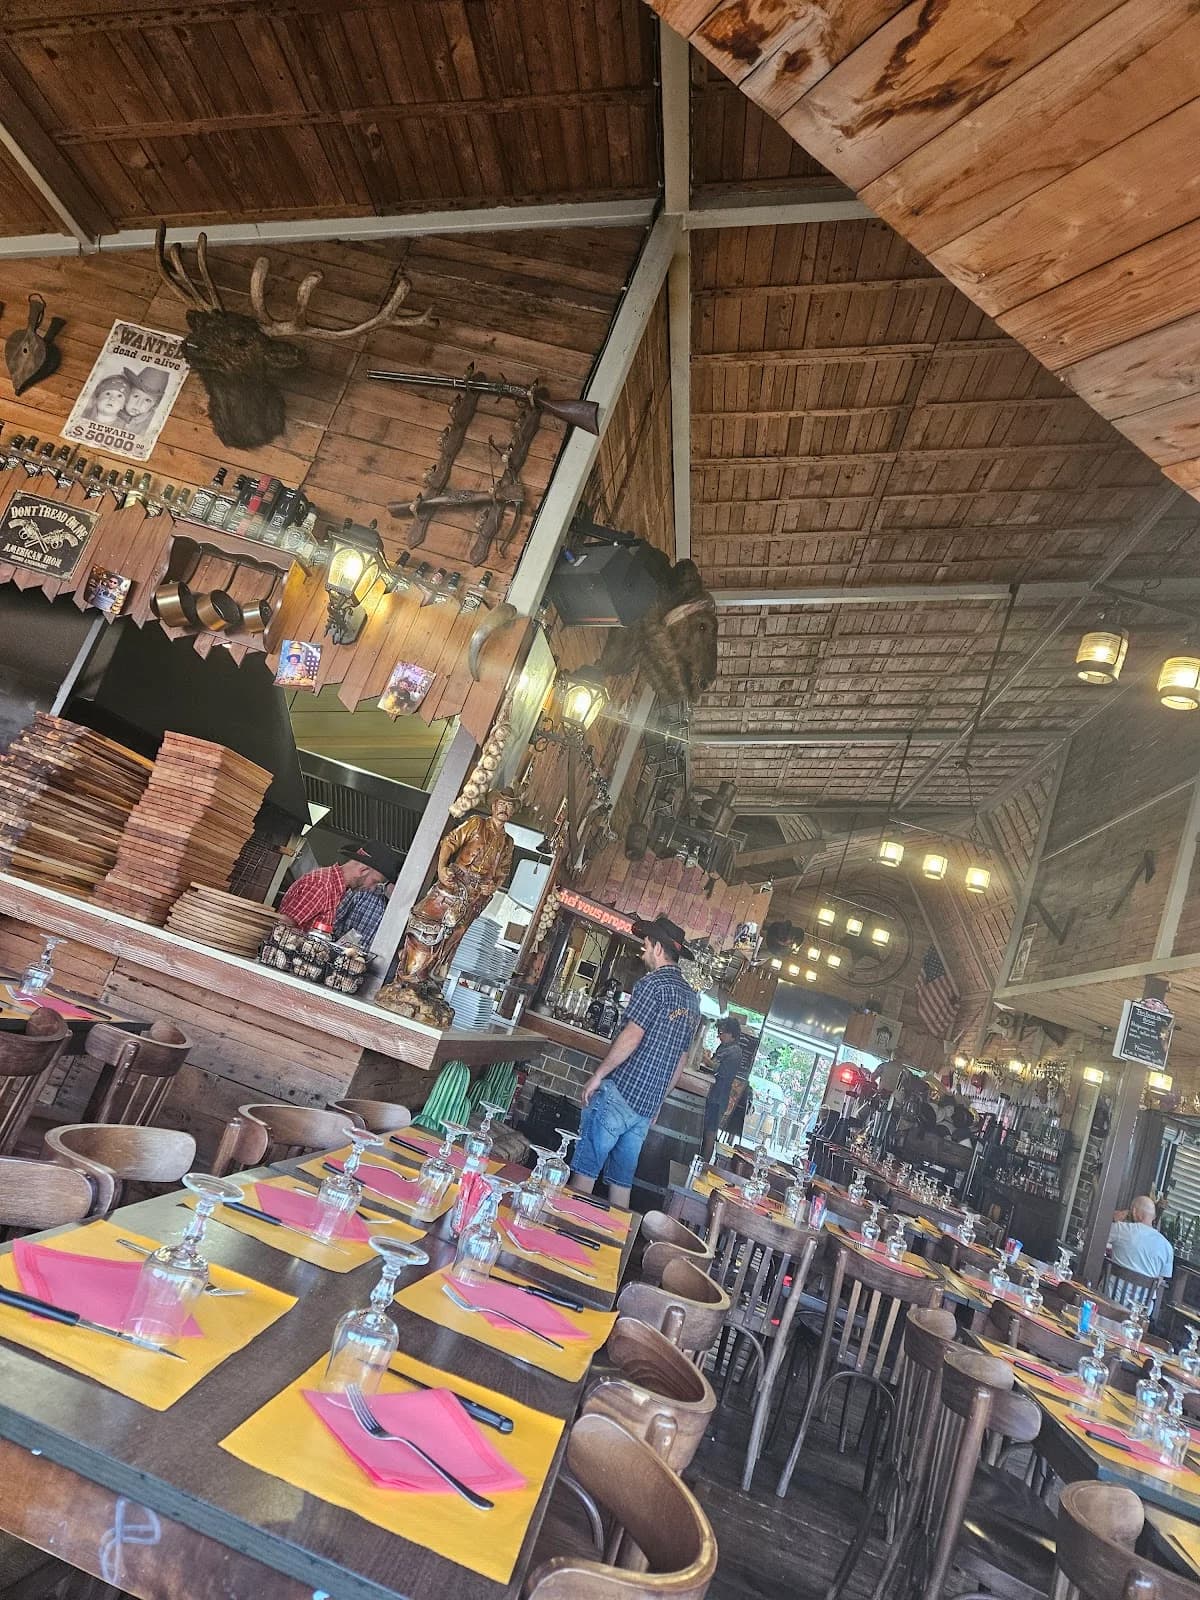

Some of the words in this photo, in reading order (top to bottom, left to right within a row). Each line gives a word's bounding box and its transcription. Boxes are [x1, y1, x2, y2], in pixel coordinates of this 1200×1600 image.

[113, 345, 138, 359] dead
[140, 354, 153, 363] or
[154, 357, 181, 371] alive
[88, 422, 136, 441] REWARD
[39, 504, 68, 523] TREAD
[65, 515, 80, 534] ON
[74, 524, 89, 541] ME
[3, 543, 43, 562] AMERICAN
[42, 554, 63, 569] IRON
[577, 900, 602, 919] vous
[600, 912, 633, 934] propo
